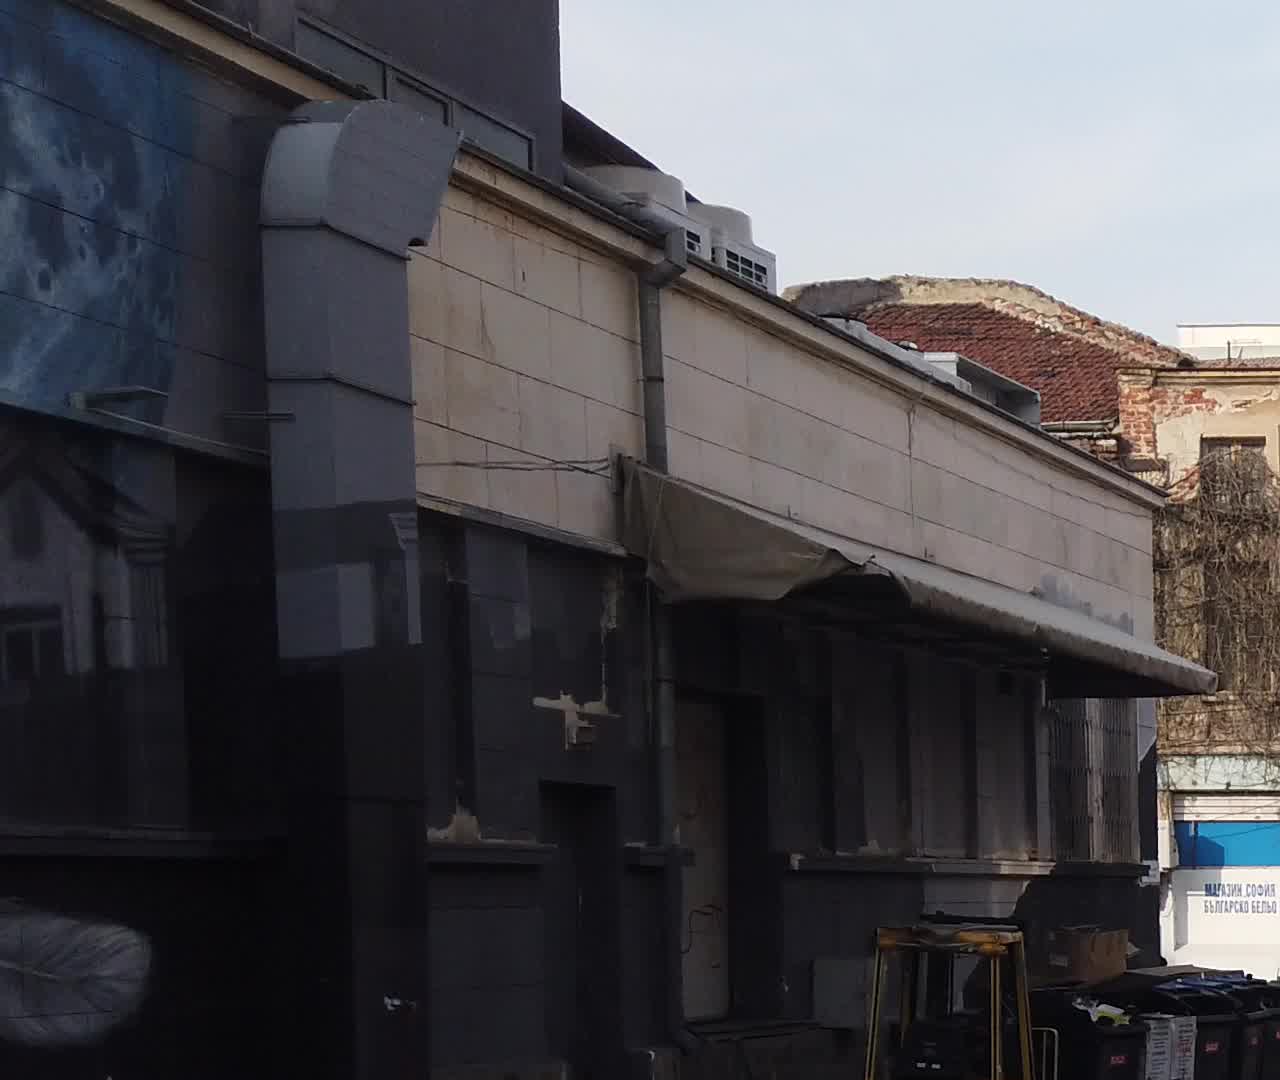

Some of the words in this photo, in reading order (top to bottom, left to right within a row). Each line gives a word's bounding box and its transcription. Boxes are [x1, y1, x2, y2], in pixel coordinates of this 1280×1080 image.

[1204, 883, 1242, 897] МАГАЗИН
[1204, 900, 1249, 914] БЪЛГАРСКО
[1251, 900, 1277, 914] БЕЛЬО
